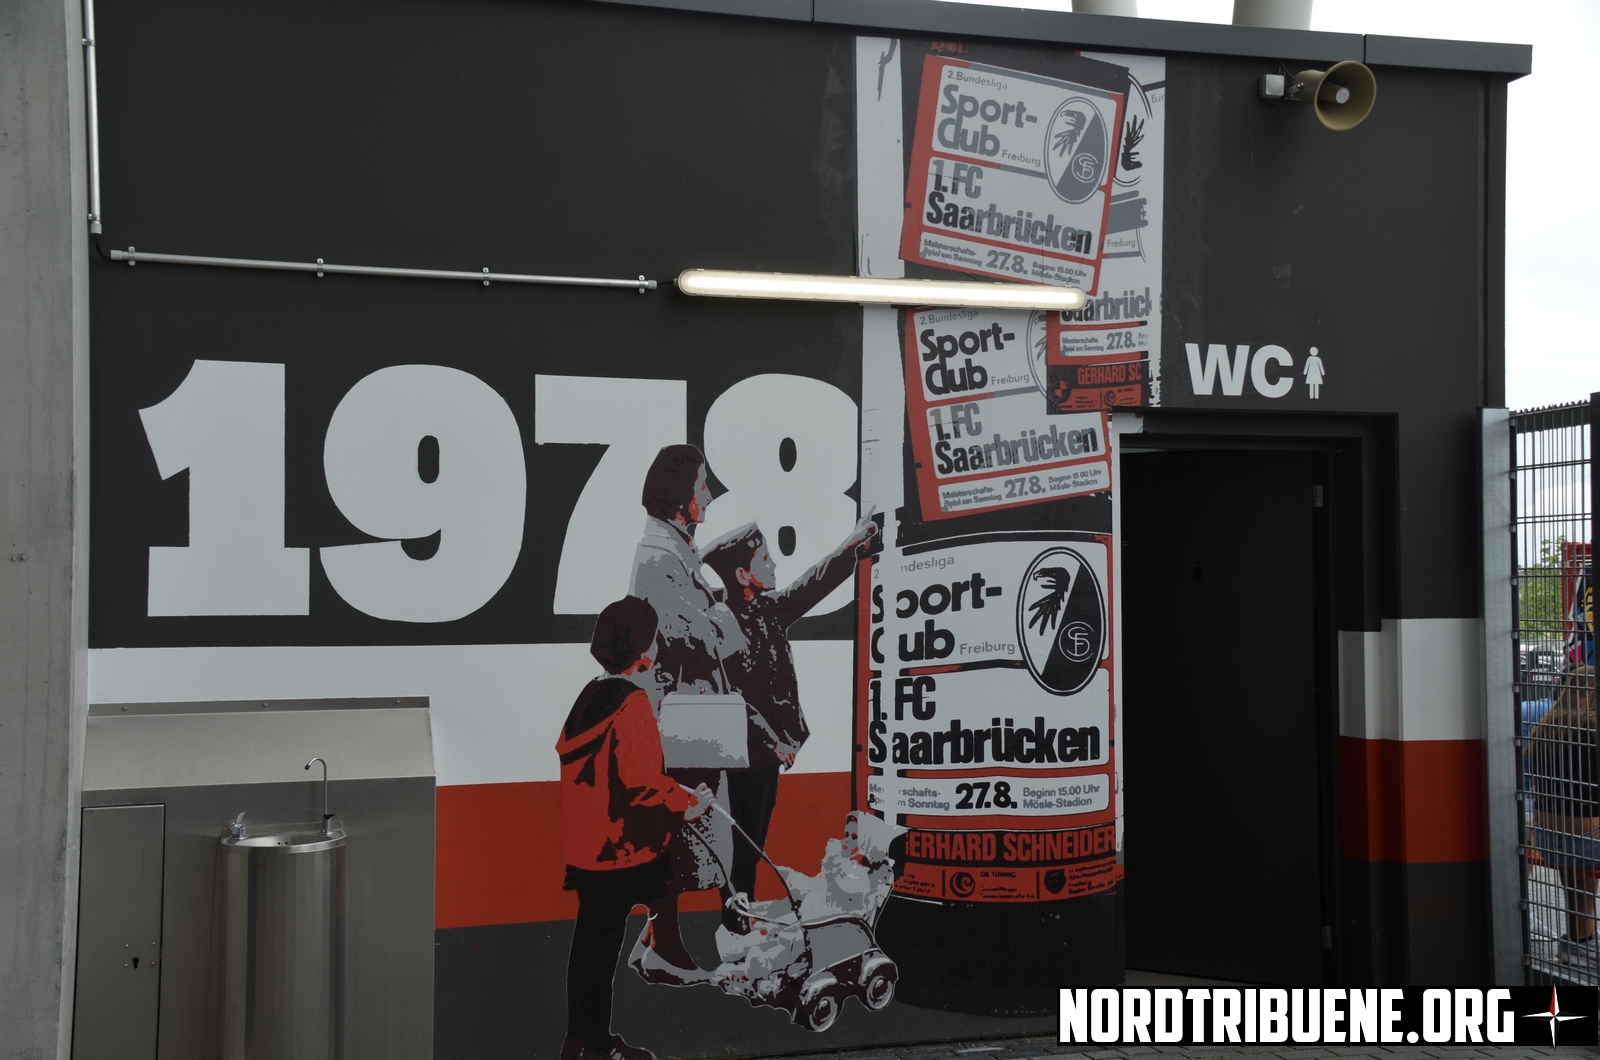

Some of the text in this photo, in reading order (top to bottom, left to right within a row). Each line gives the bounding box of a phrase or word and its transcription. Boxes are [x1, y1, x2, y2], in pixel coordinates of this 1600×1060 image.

[940, 83, 1038, 130] Sport-
[1001, 149, 1041, 168] Freiburg
[926, 191, 1093, 255] Saarbrücken
[1107, 239, 1135, 249] Freiburg
[986, 250, 1028, 275] 27.8.
[1075, 268, 1088, 278] Uhr
[920, 322, 1015, 362] Sport-
[1106, 331, 1136, 350] 27.8.
[991, 373, 1029, 386] Freiburg
[1077, 364, 1126, 385] GERHARD
[1185, 343, 1294, 398] WC
[935, 424, 1099, 475] Saarbrücken
[1090, 468, 1102, 477] Uhr
[138, 358, 860, 623] 1978
[1004, 475, 1047, 499] 27.8.
[871, 619, 955, 664] Cub
[959, 640, 1016, 656] Freiburg
[869, 716, 1100, 765] Saarbrücken
[955, 781, 1018, 810] 27.8.
[1023, 783, 1101, 798] Beginn 15.00 Uhr
[908, 798, 950, 811] Sonntag
[1003, 824, 1116, 863] SCHNEIDER
